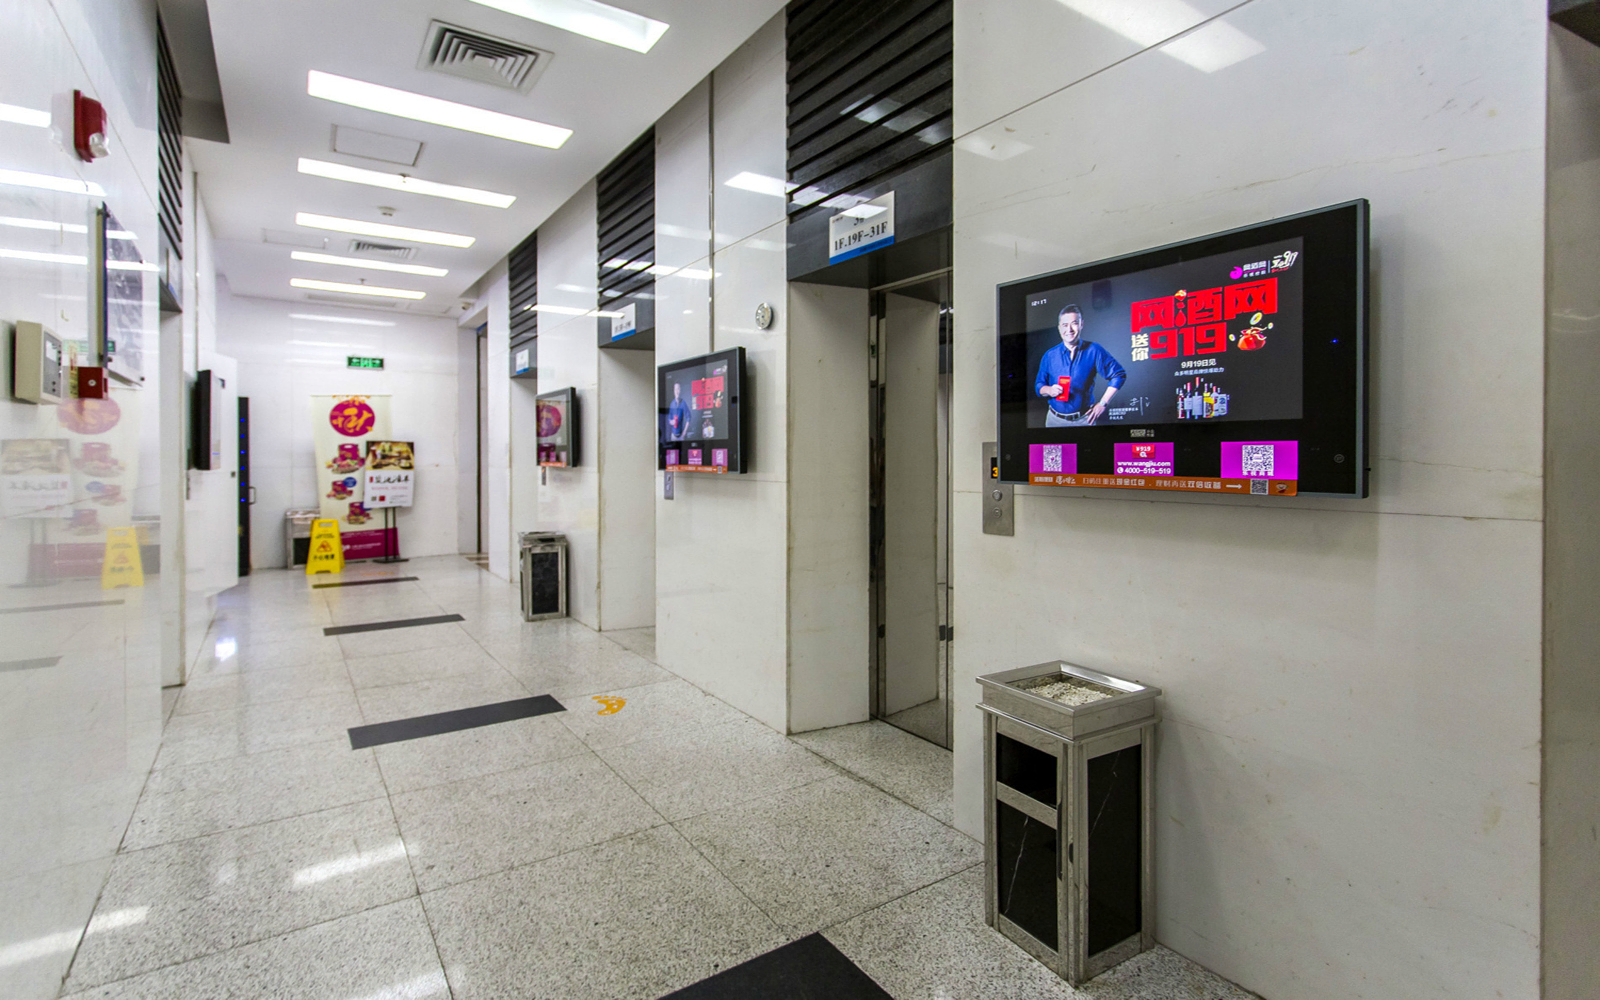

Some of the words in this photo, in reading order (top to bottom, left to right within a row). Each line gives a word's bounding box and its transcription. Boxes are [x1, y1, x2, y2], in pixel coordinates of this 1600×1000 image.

[1131, 277, 1278, 333] 网酒网
[1131, 333, 1149, 362] 送你
[1150, 322, 1227, 359] 919
[1181, 358, 1217, 369] 9月19日见
[1124, 467, 1172, 475] 4000-519-519
